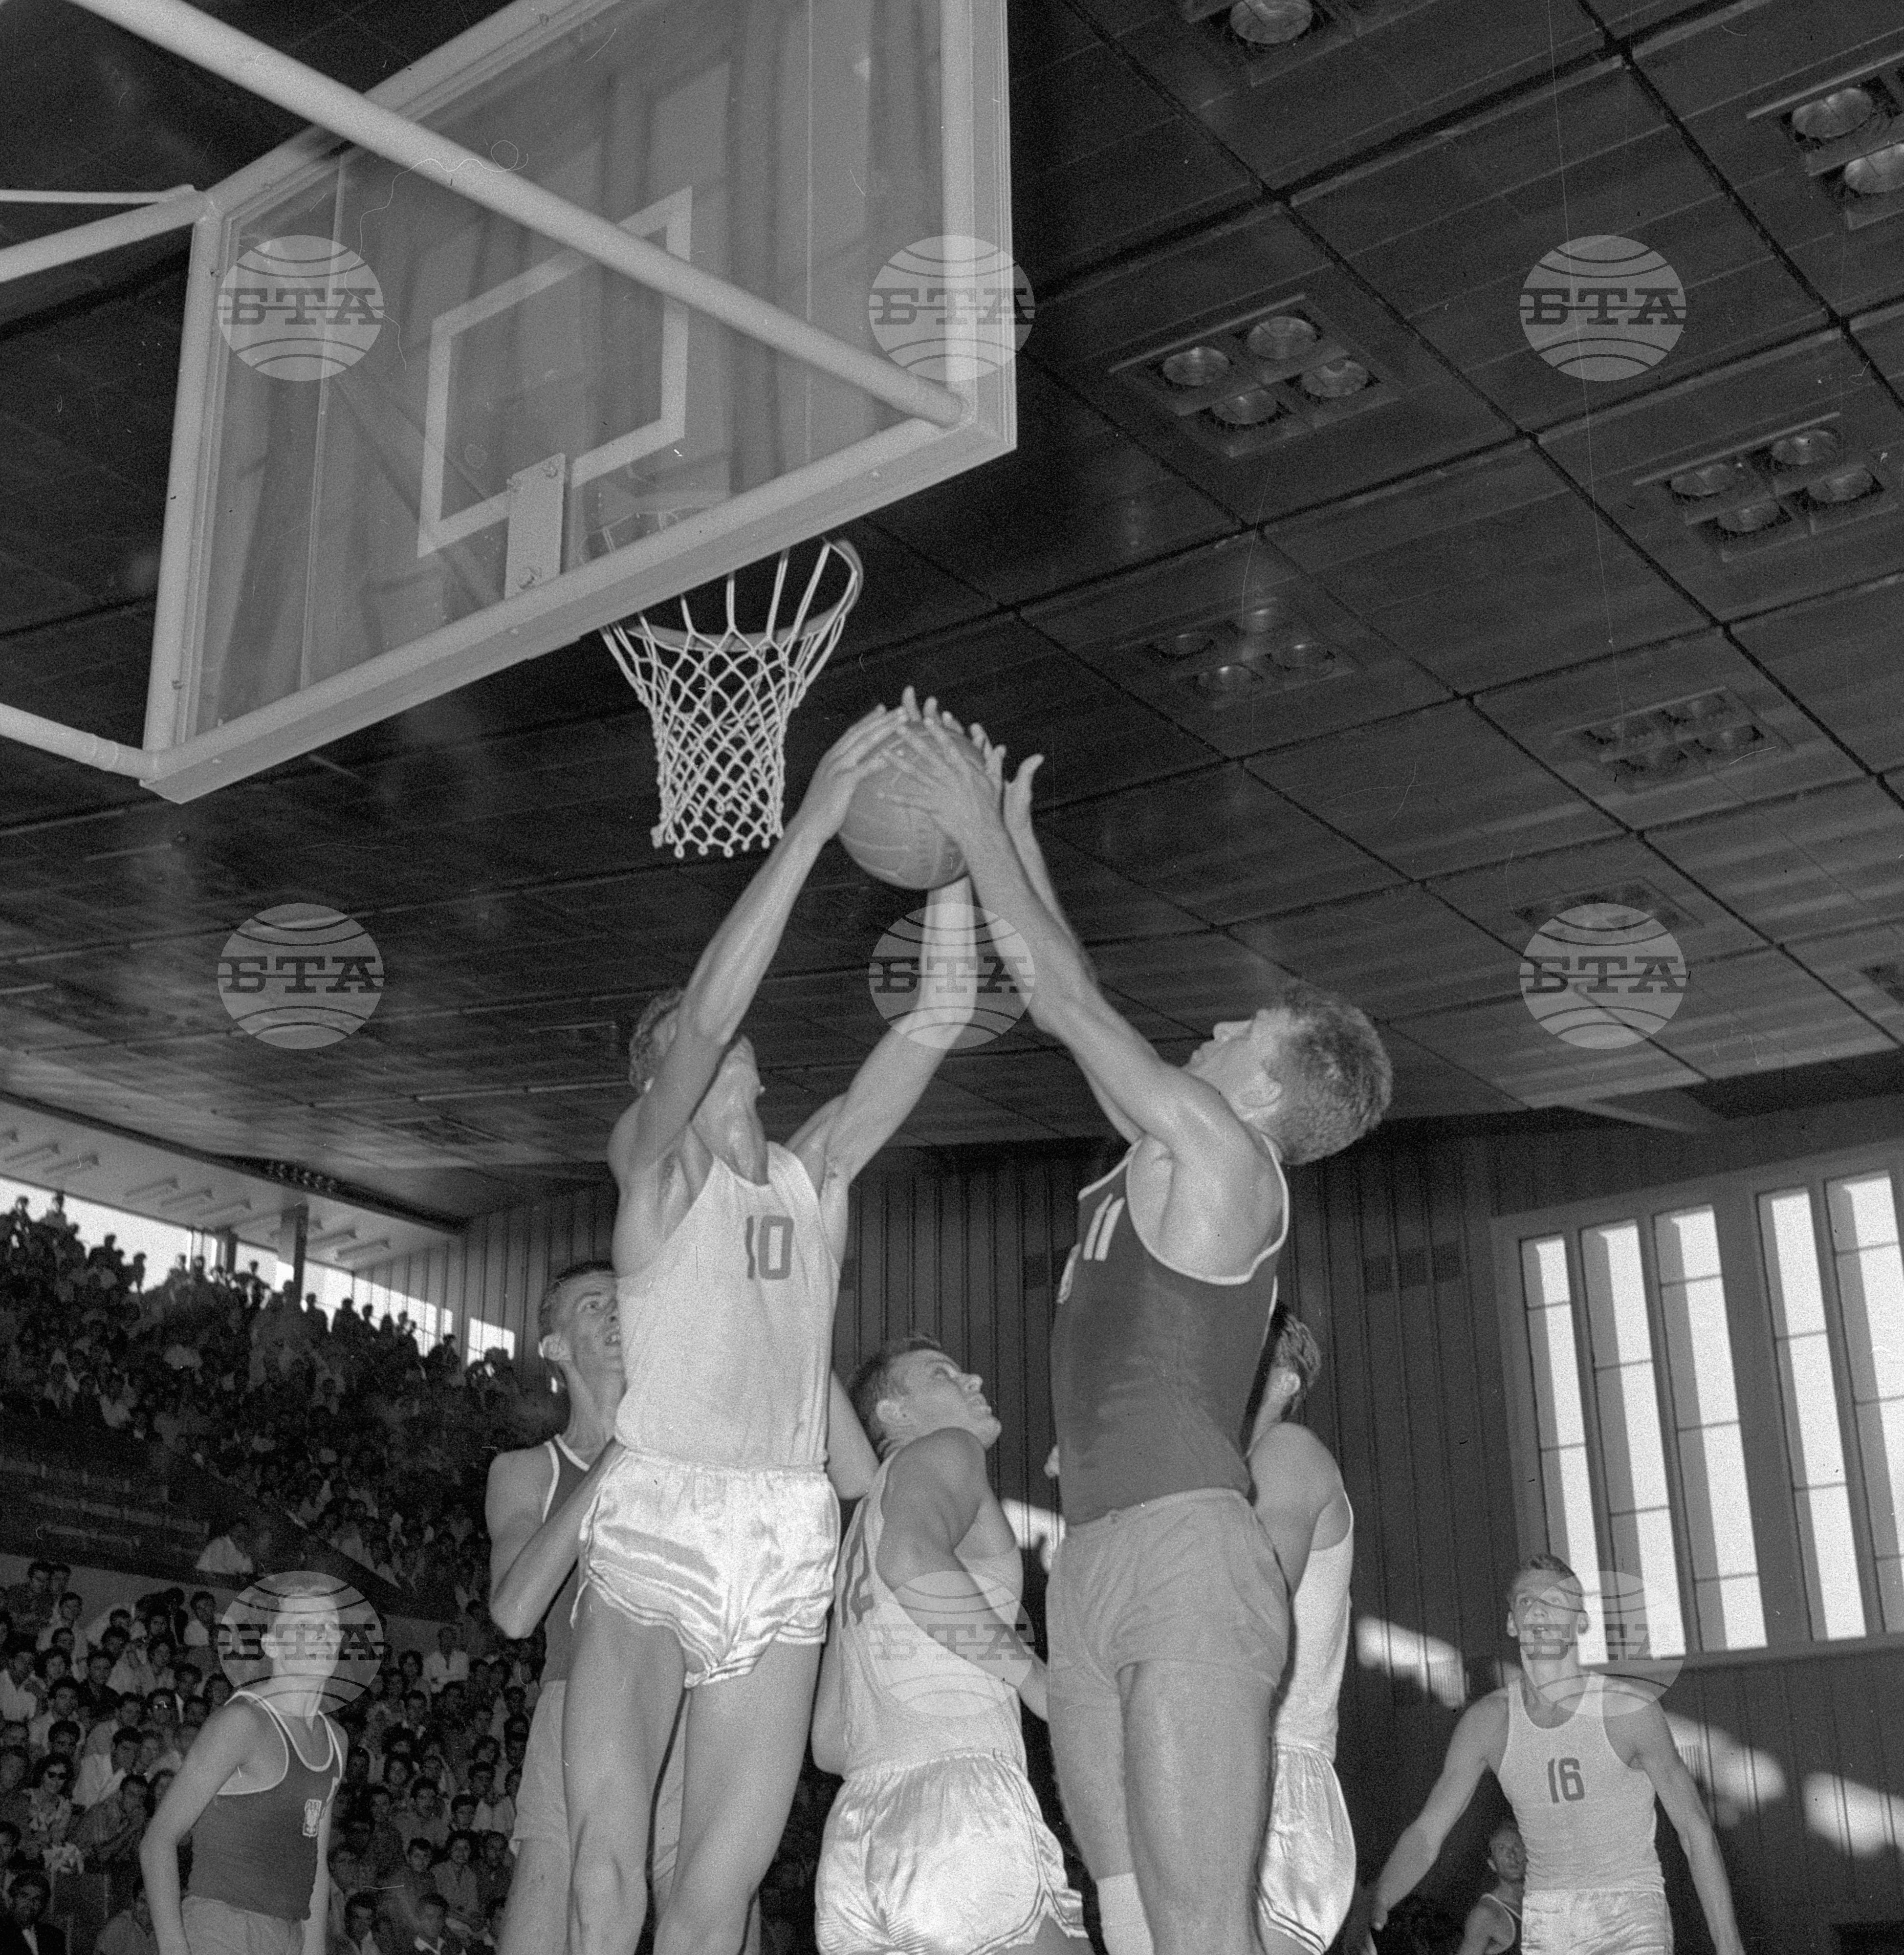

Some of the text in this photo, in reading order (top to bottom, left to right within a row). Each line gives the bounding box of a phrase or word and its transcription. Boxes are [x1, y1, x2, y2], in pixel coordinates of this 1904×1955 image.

[745, 1215, 794, 1280] 10
[1083, 1193, 1125, 1261] 11
[1548, 1757, 1585, 1803] 16
